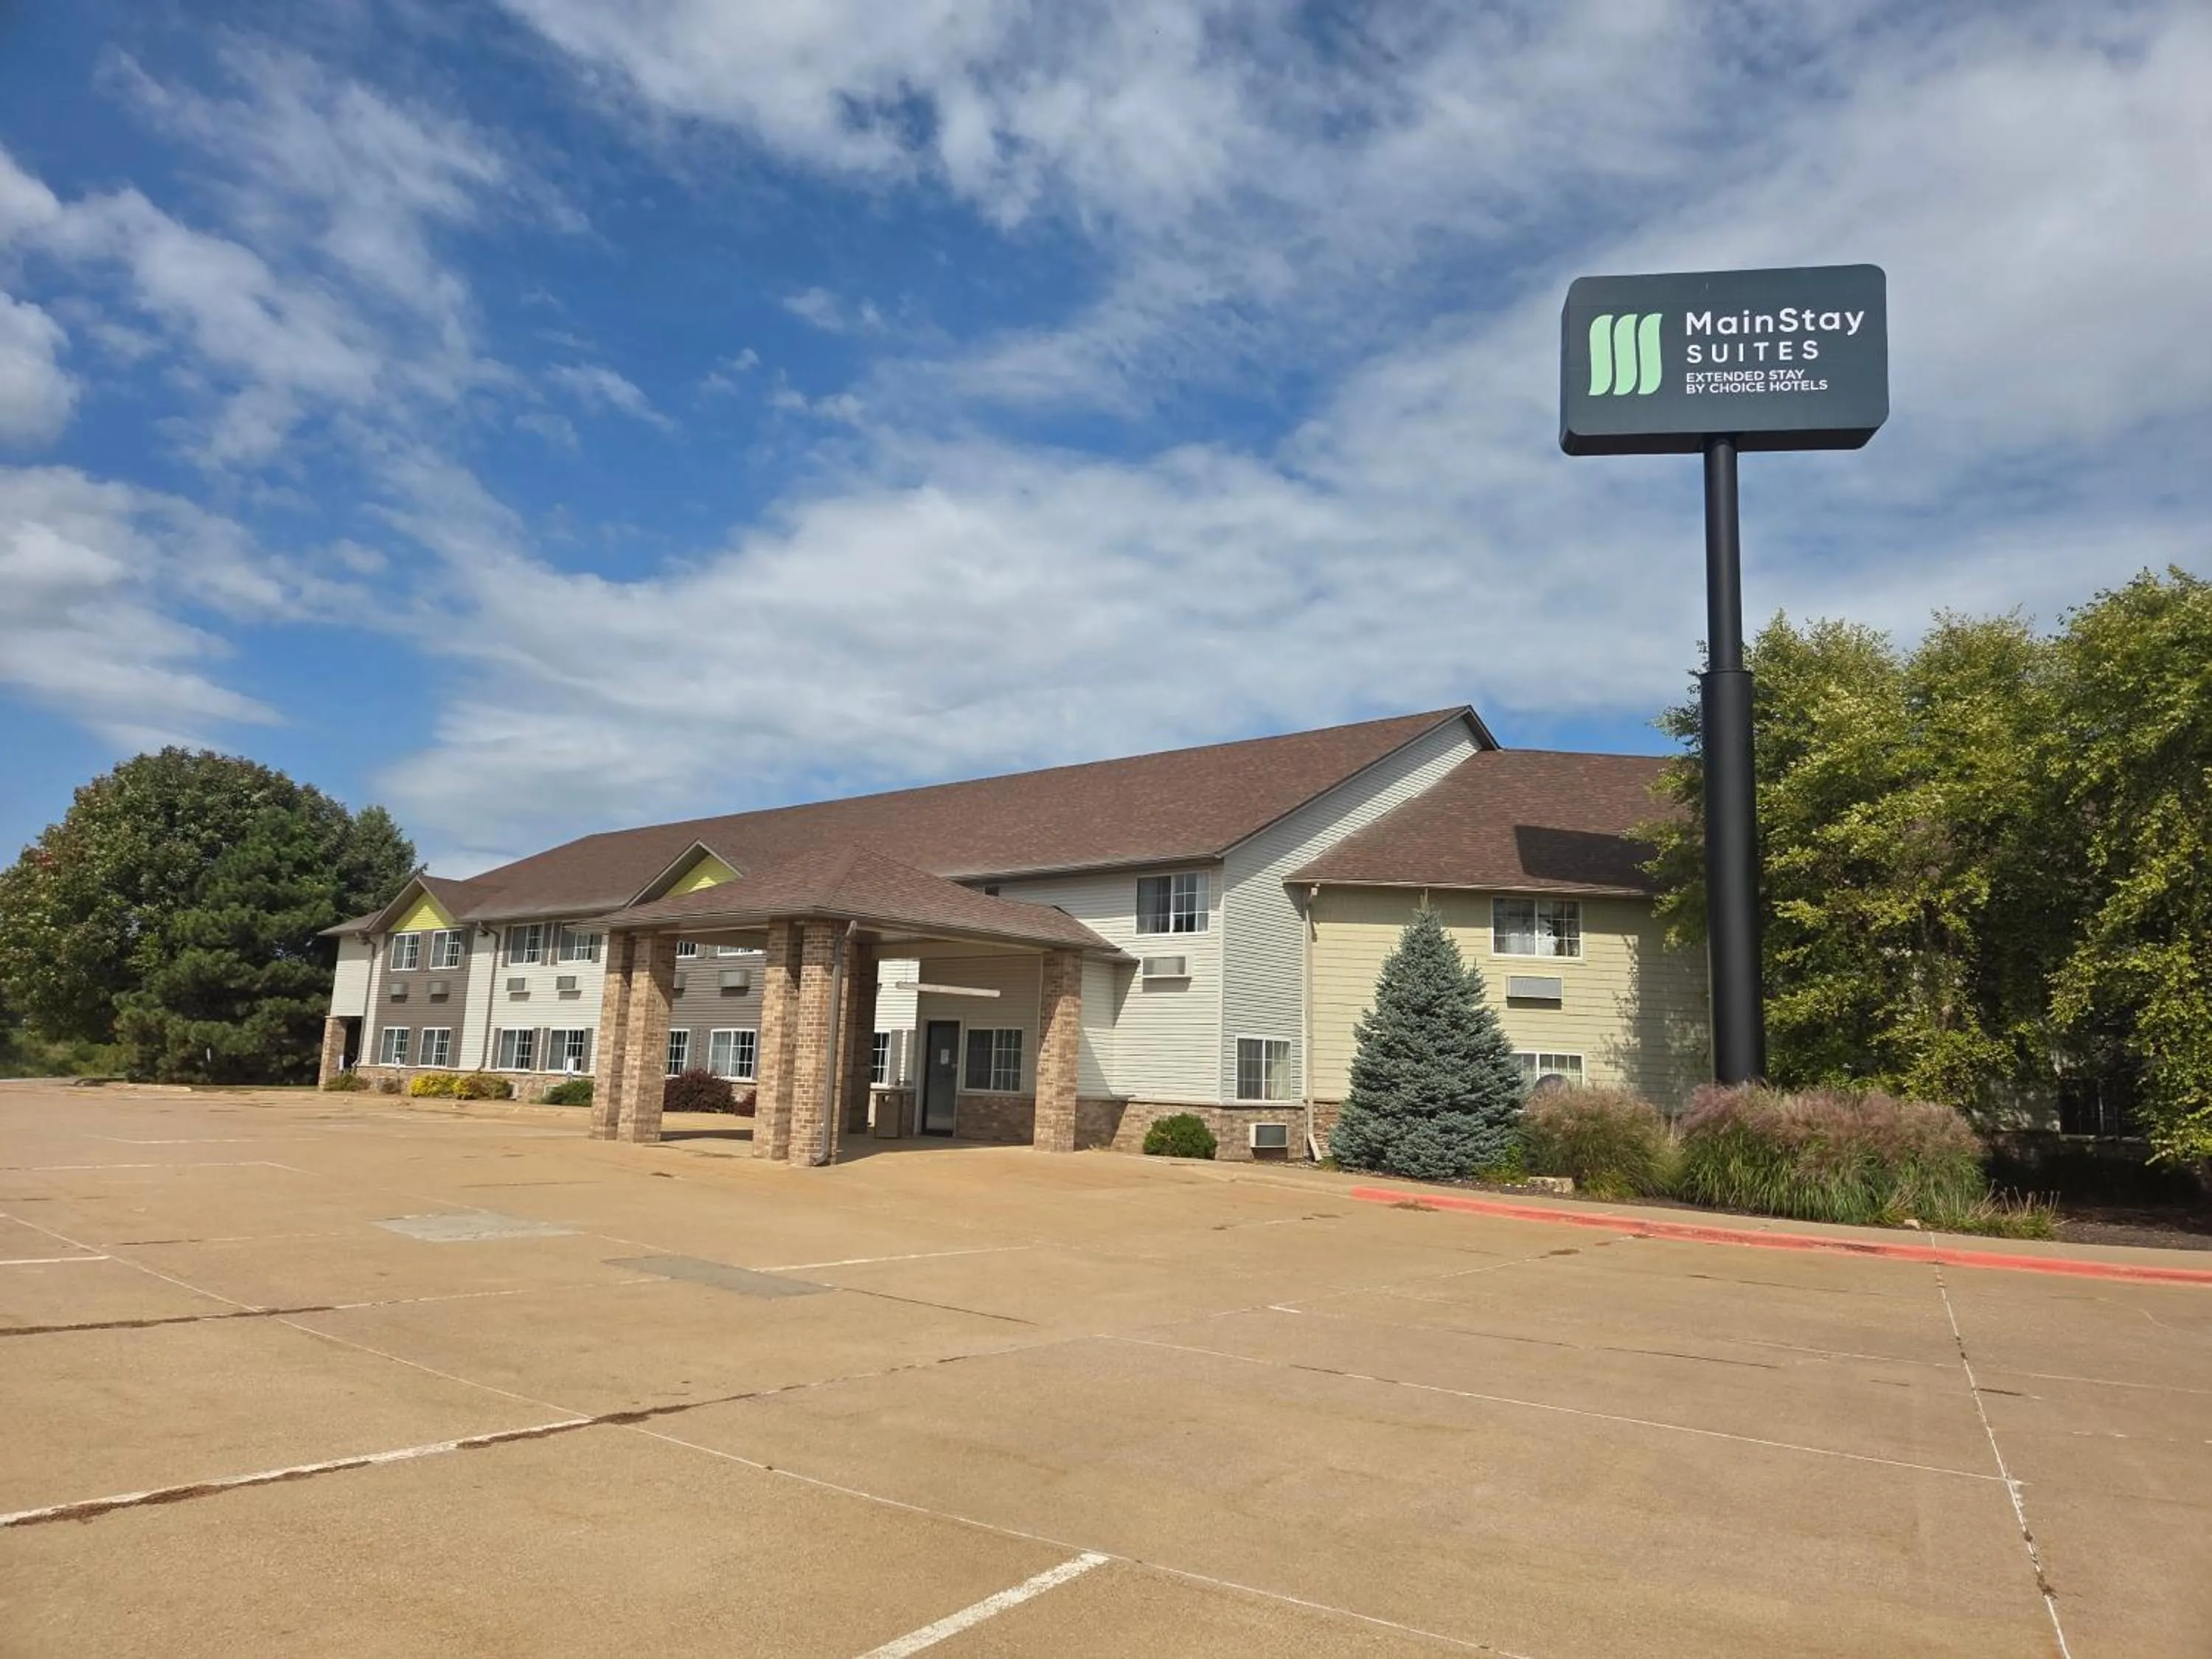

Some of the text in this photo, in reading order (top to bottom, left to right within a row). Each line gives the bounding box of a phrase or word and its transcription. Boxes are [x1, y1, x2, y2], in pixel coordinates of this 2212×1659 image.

[1686, 307, 1865, 335] MainStay
[1686, 340, 1820, 364] SUITES
[1686, 369, 1805, 383] EXTENDED STAY
[1686, 380, 1829, 394] BY CHOICE HOTELS
